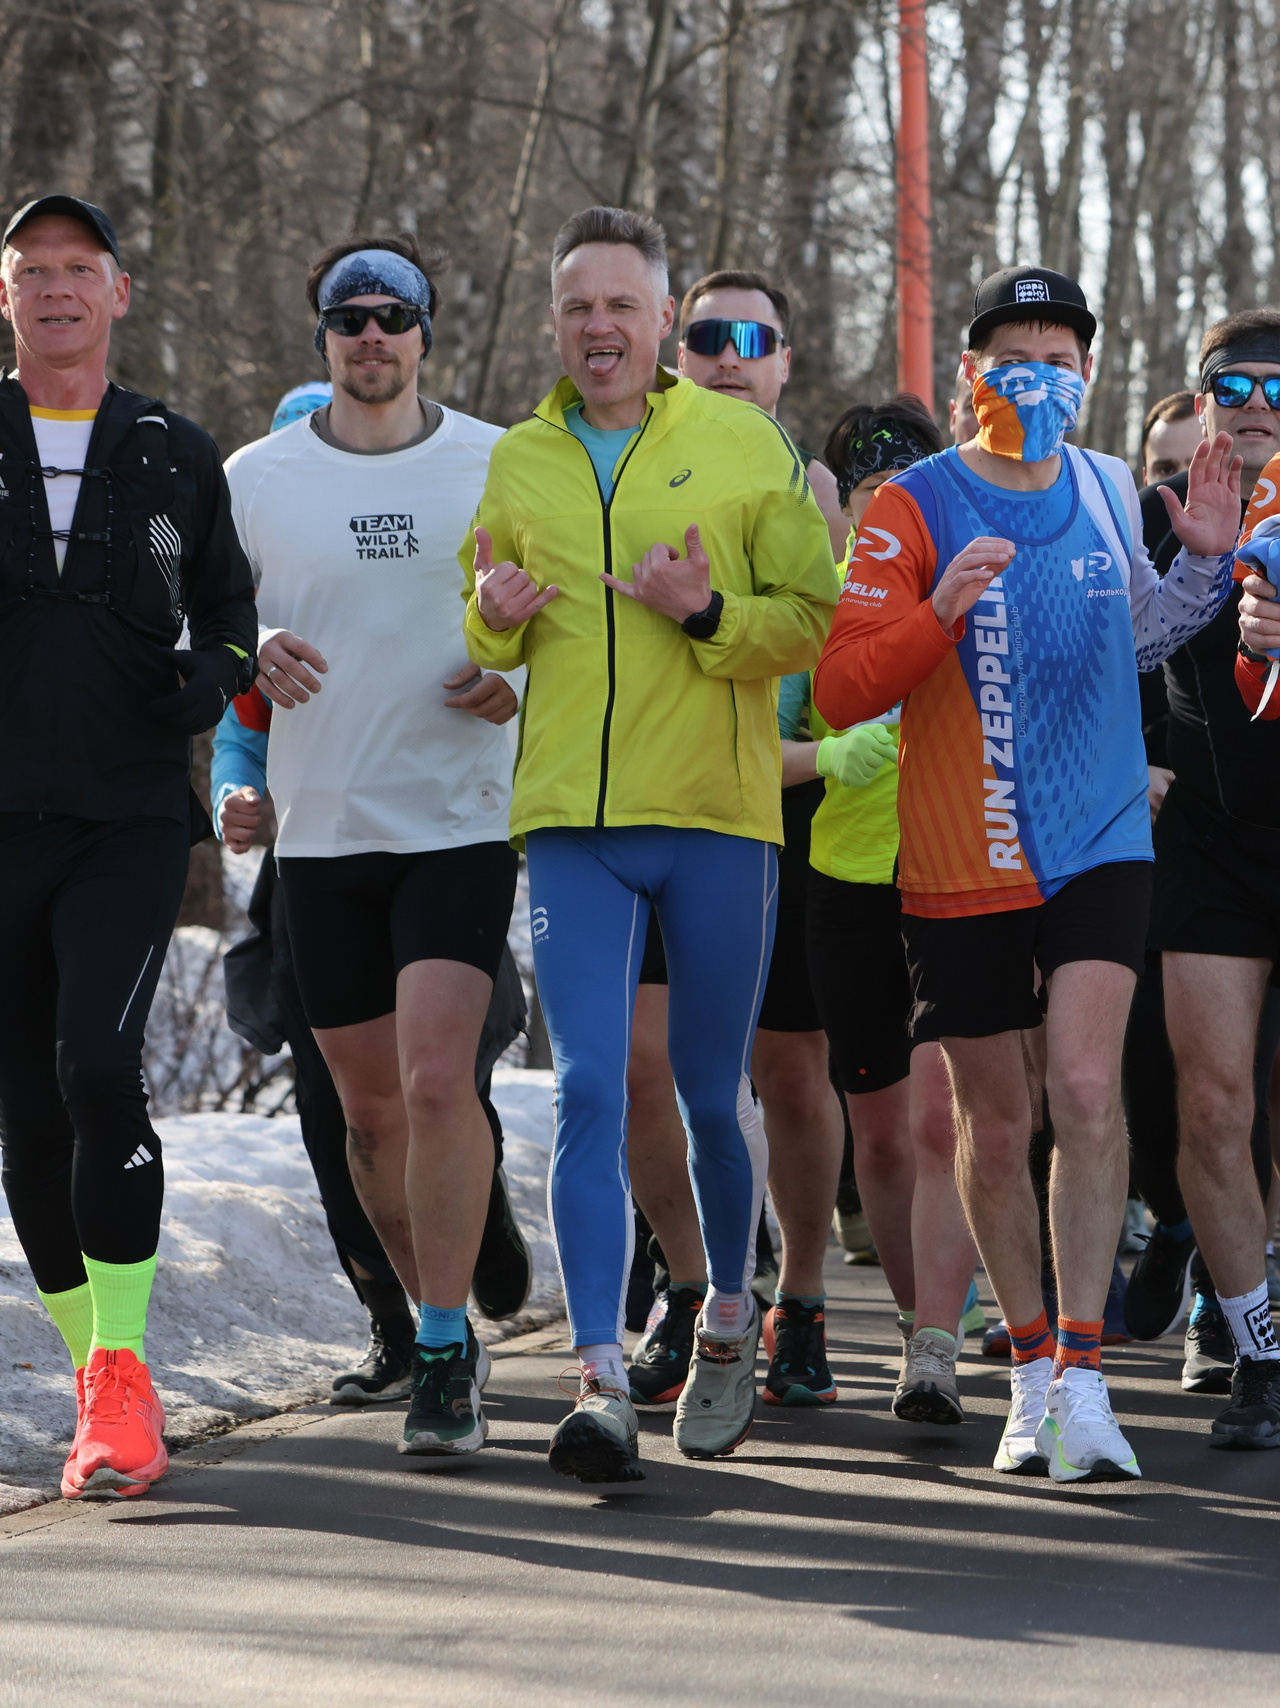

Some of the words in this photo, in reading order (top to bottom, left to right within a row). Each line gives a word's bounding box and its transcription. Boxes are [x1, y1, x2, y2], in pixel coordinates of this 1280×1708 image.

[352, 515, 412, 532] TEAM
[356, 534, 399, 546] WILD
[356, 547, 404, 560] TRAIL
[1010, 605, 1020, 627] club
[1012, 630, 1024, 670] running
[983, 777, 1022, 871] RUN
